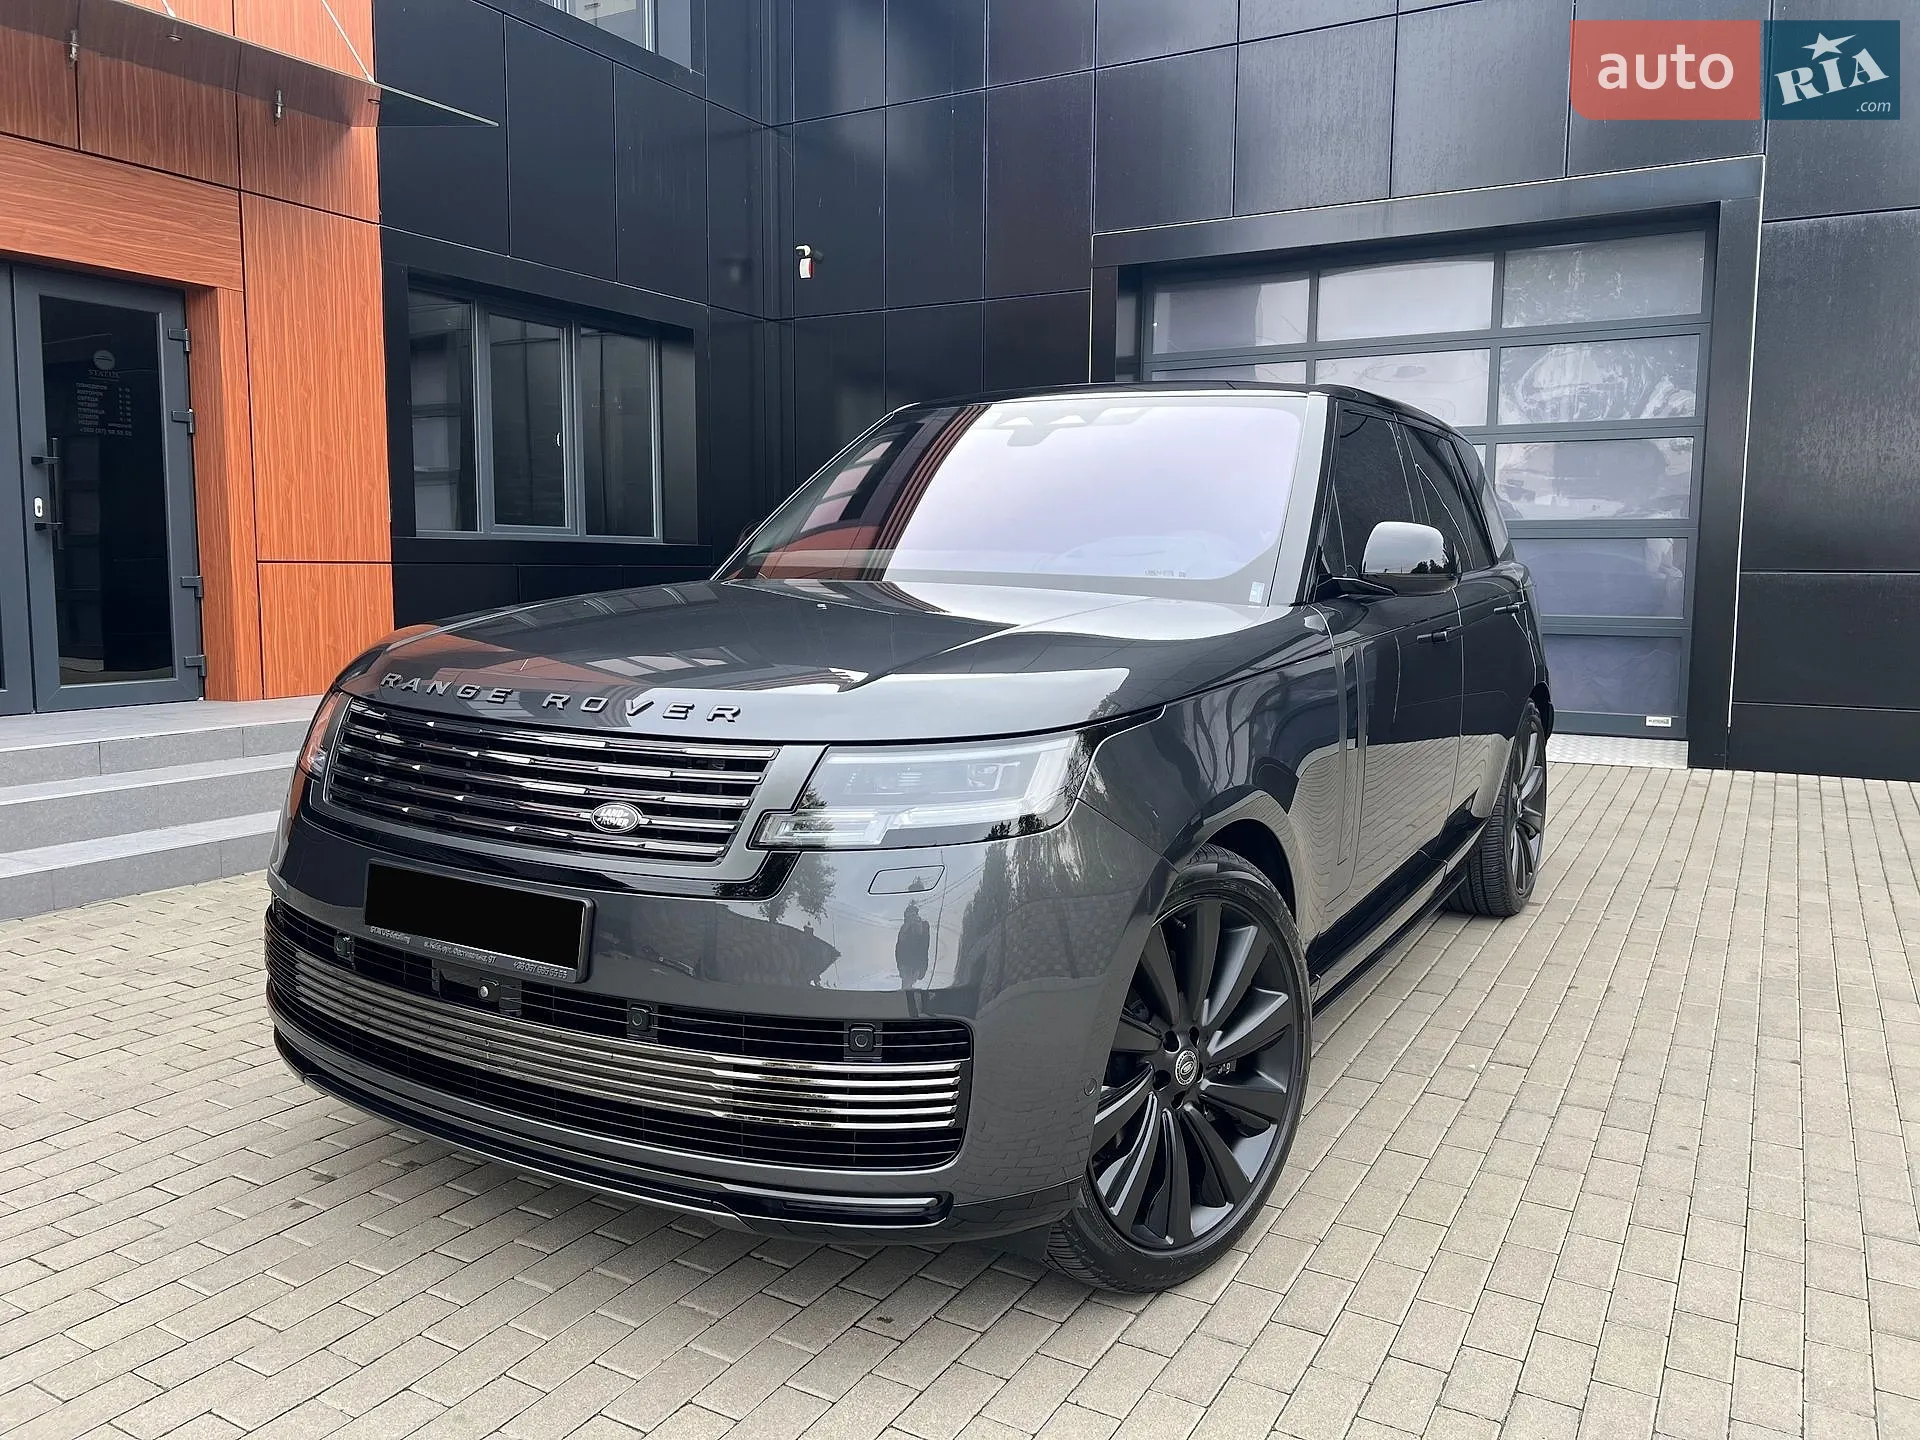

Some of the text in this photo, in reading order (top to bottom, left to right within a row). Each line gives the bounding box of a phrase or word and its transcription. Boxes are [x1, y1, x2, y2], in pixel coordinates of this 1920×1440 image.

[380, 671, 742, 723] RANGE ROVER
[599, 808, 624, 817] LAND
[600, 816, 630, 827] ROVER
